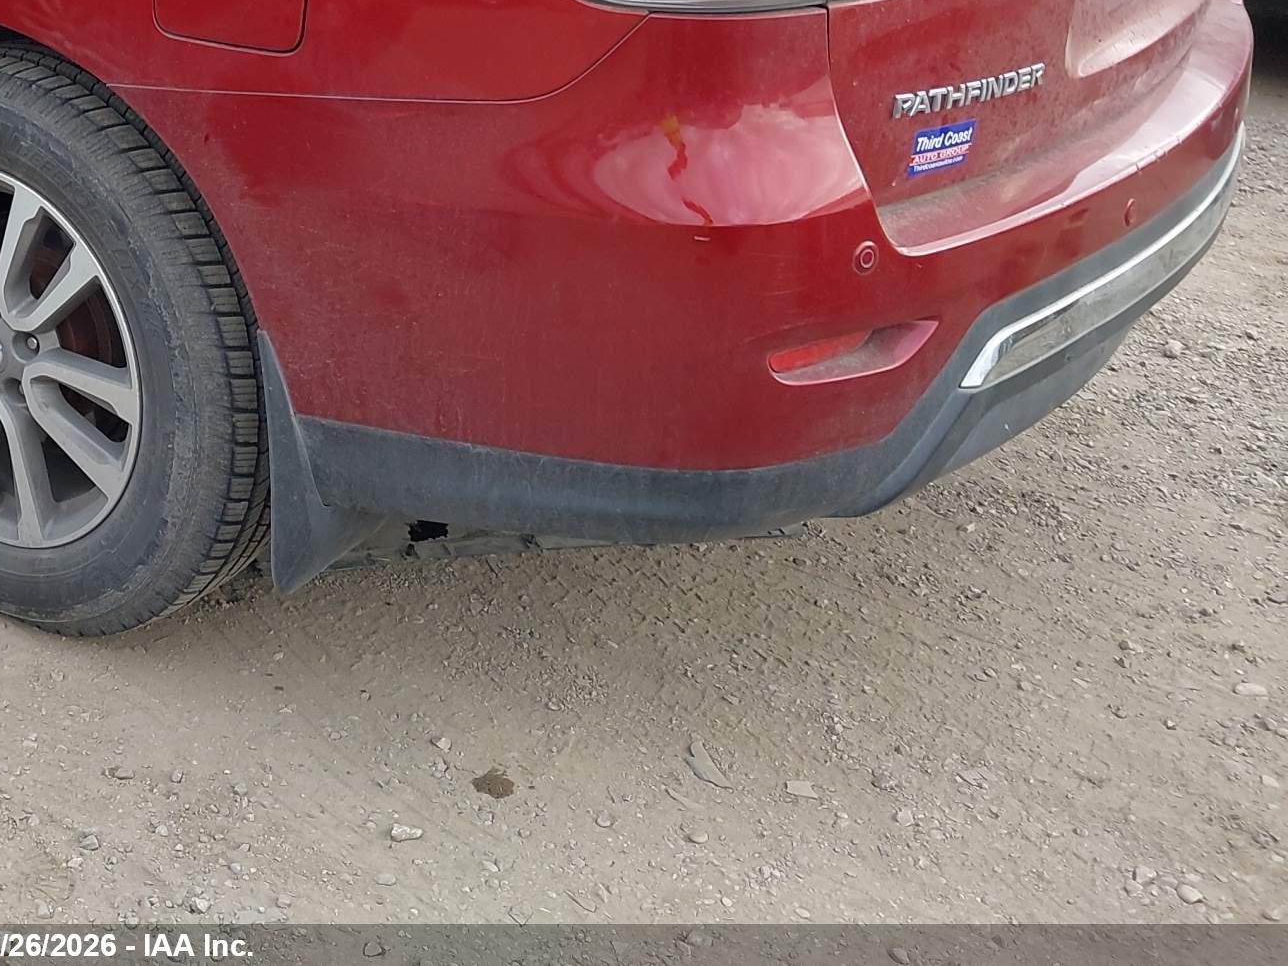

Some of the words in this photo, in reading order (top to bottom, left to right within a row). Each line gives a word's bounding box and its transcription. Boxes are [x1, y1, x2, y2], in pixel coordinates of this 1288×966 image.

[893, 62, 1046, 119] PATHFINDER
[916, 133, 944, 152] Third
[944, 127, 973, 146] Coast
[913, 151, 938, 165] AUTO
[939, 145, 969, 160] GROUP
